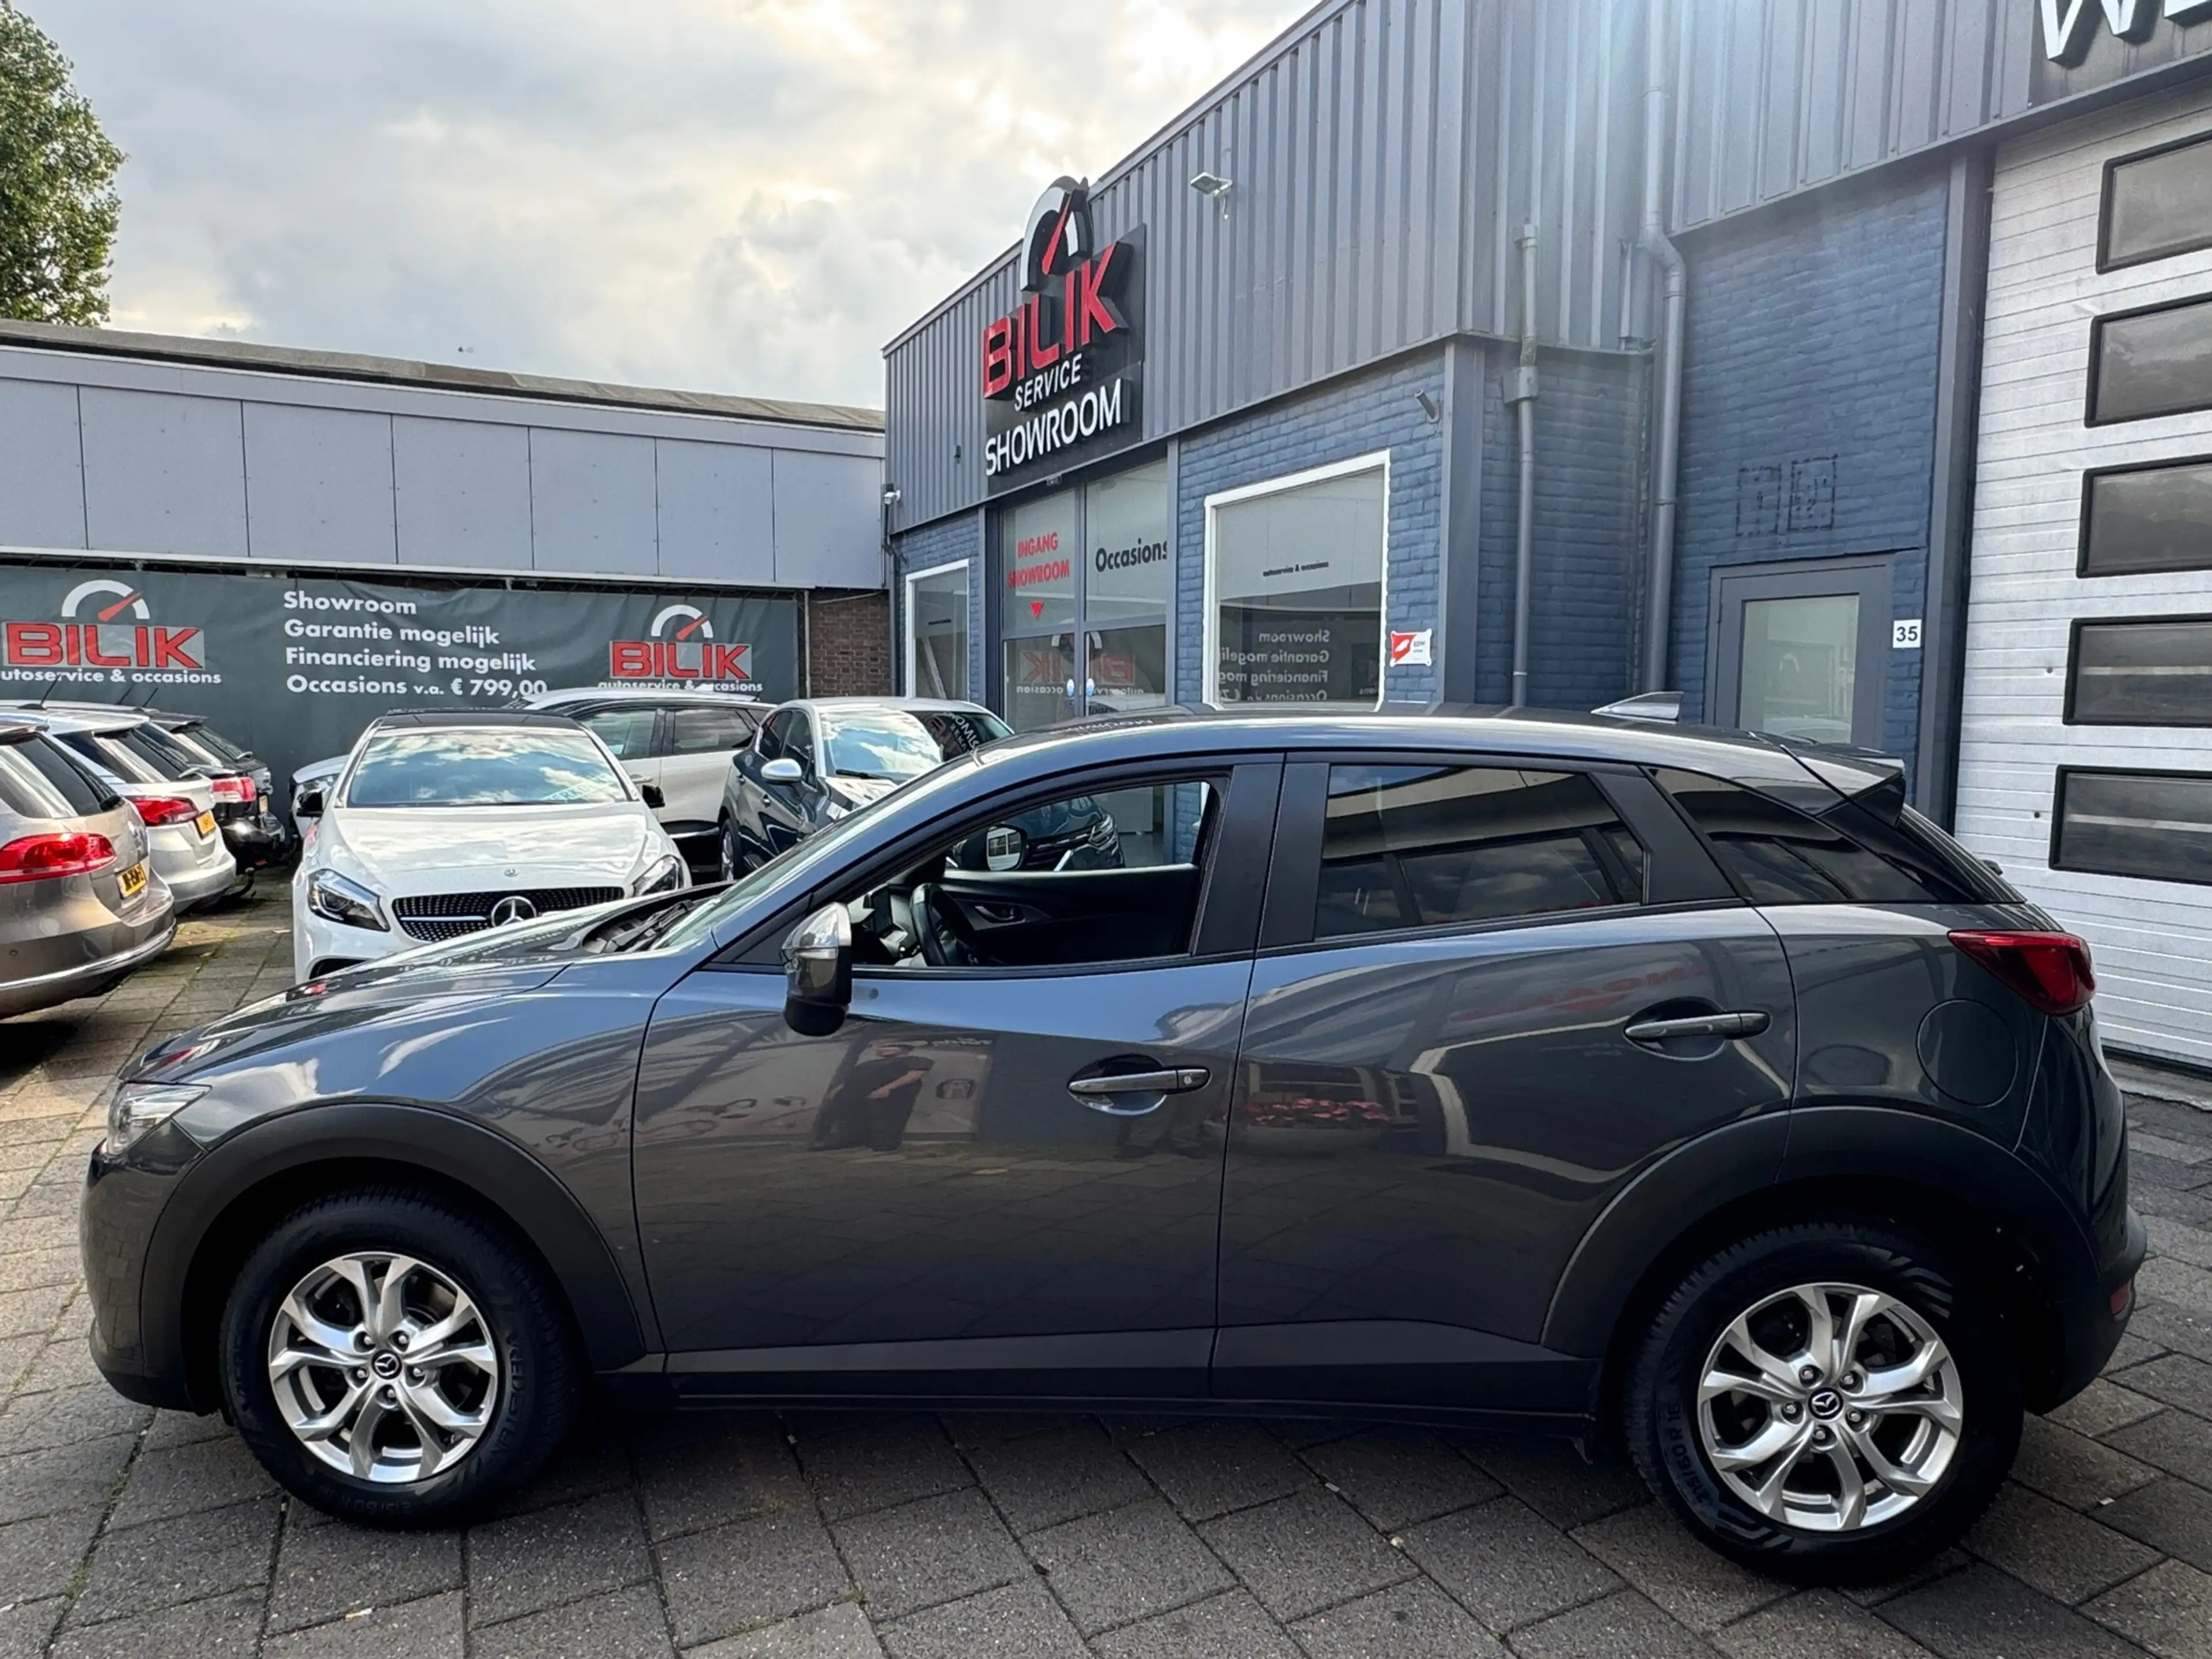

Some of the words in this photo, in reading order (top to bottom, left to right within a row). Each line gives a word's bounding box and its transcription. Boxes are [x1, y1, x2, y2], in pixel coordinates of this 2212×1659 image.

[983, 241, 1118, 400] BILIK
[1014, 353, 1083, 412] SERVICE
[984, 378, 1122, 477] SHOWROOM
[1017, 532, 1059, 559] INGANG
[1006, 559, 1070, 589] SHOWROOM
[283, 590, 417, 615] Showroom
[5, 622, 203, 669] BILIK
[284, 619, 393, 640] Garantie
[400, 626, 500, 649] mogelijk
[1896, 626, 1918, 642] 35
[285, 647, 431, 673] Financiering
[438, 653, 536, 675] mogelijk
[612, 641, 751, 680] BILIK
[0, 667, 105, 683] utoservice
[111, 669, 127, 684] &
[131, 669, 222, 684] occasions
[286, 674, 407, 694] Occasions
[413, 685, 445, 696] v.a.
[450, 677, 463, 696] €
[469, 679, 547, 699] 799,00
[700, 681, 764, 692] casions
